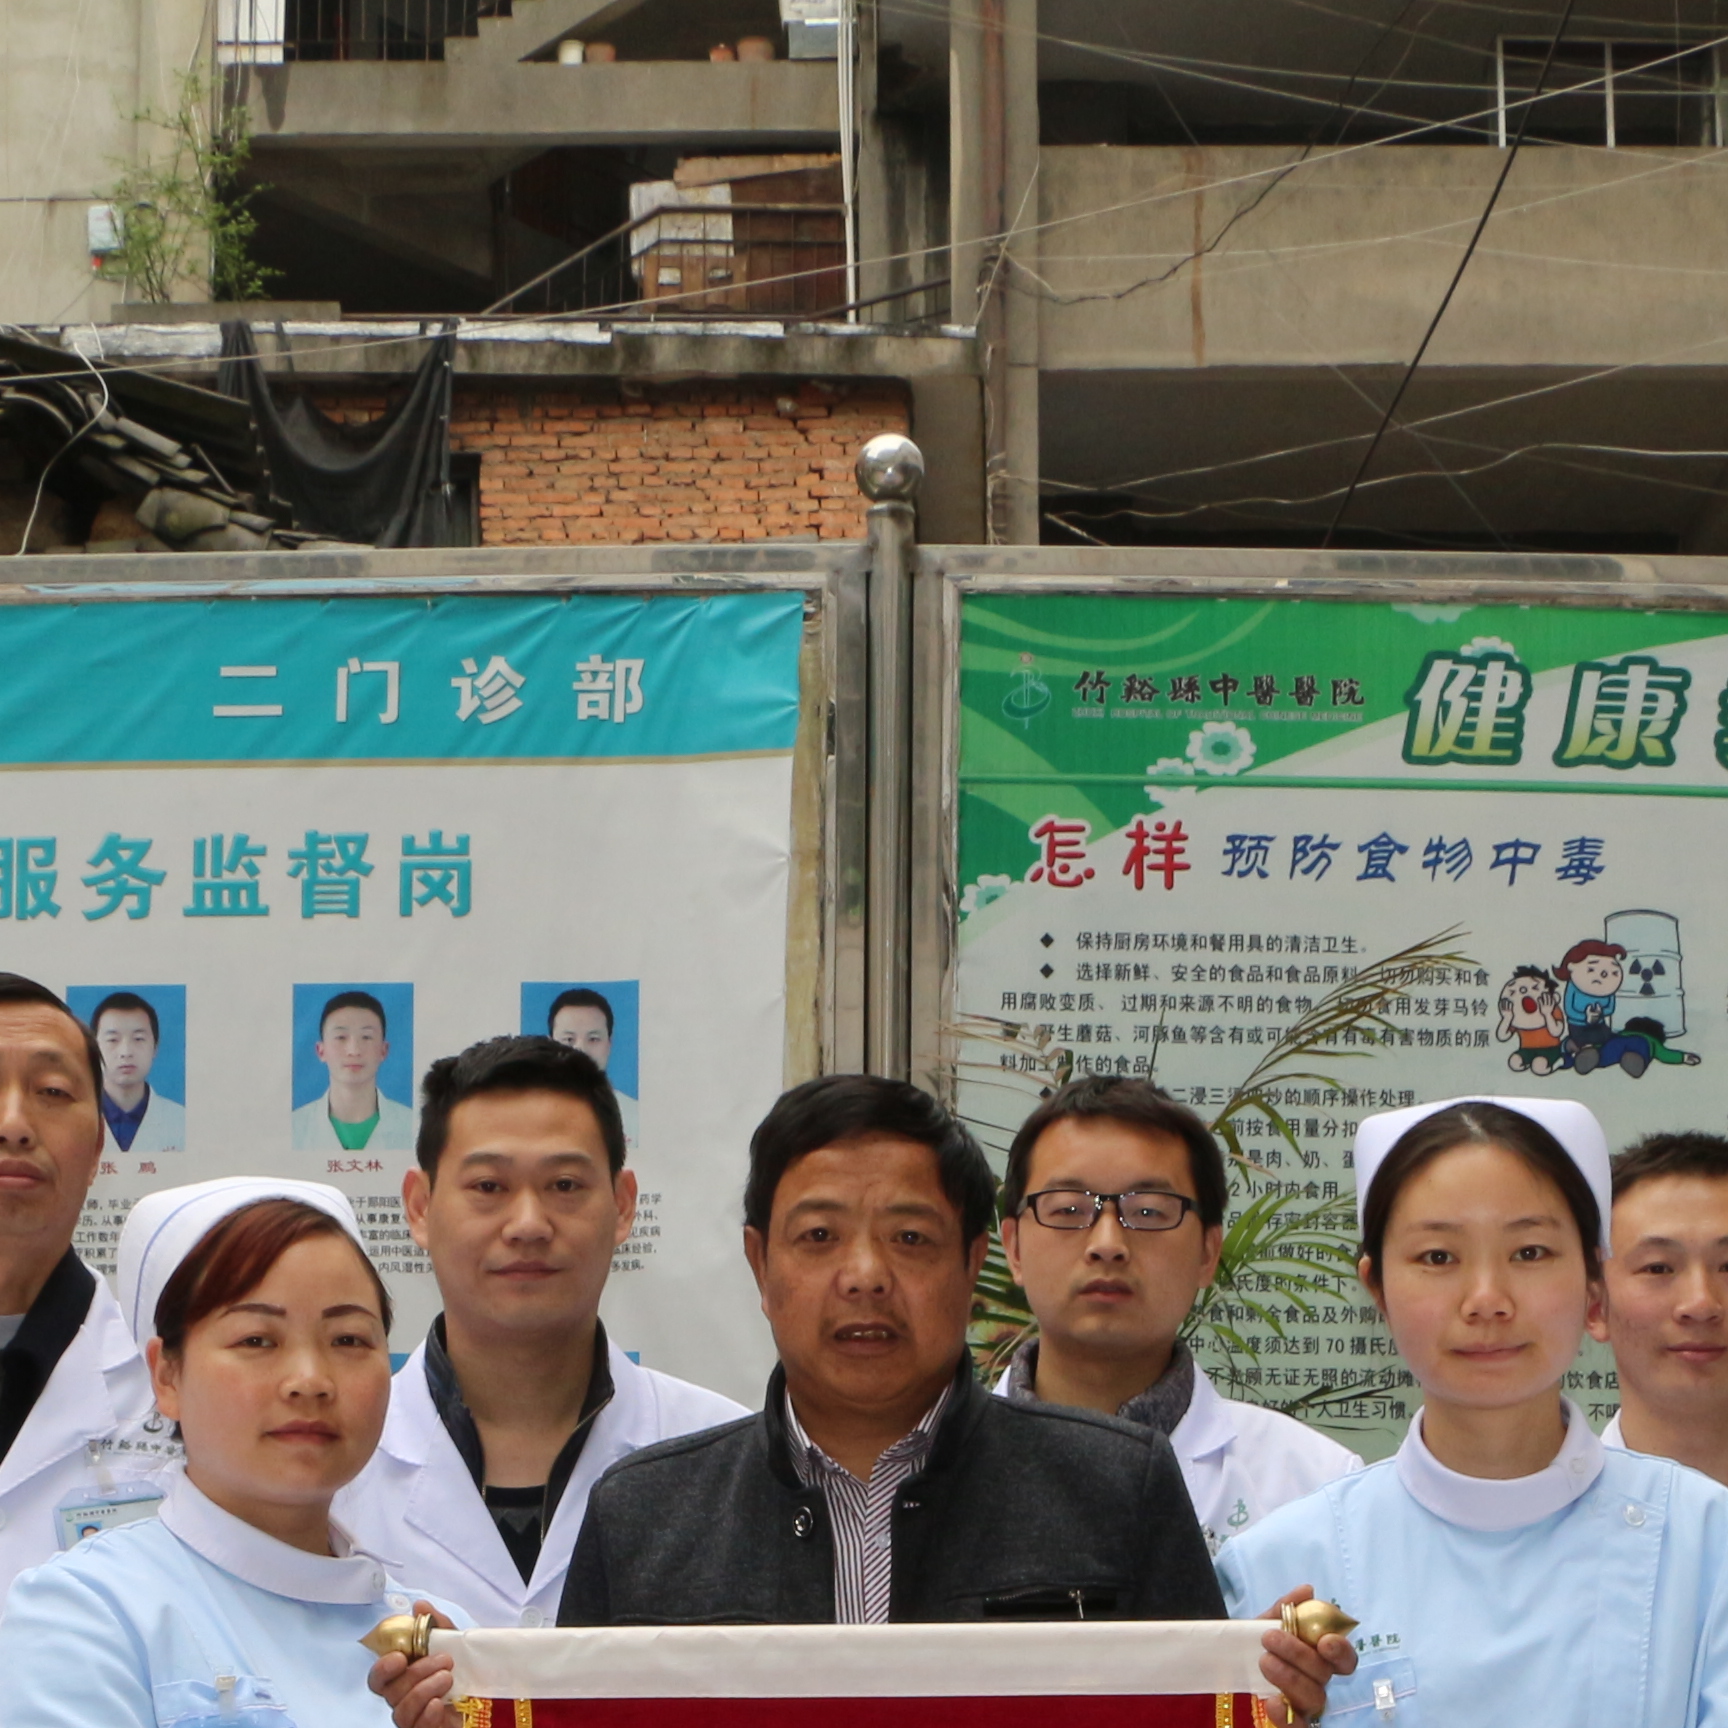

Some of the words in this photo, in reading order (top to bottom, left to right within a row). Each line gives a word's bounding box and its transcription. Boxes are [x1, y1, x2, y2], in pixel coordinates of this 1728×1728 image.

[212, 655, 647, 725] 二门诊部
[1027, 813, 1192, 891] 怎样
[1221, 831, 1607, 888] 预防食物中毒
[1075, 931, 1369, 956] 保持厨房环境和餐用具的清洁卫生。
[1075, 962, 1491, 989] 选择新鲜、安全的食品和食品原料切勿购买和食
[327, 1159, 384, 1173] 张文林
[1208, 1365, 1422, 1388] 不光顾无证无照的流动摊
